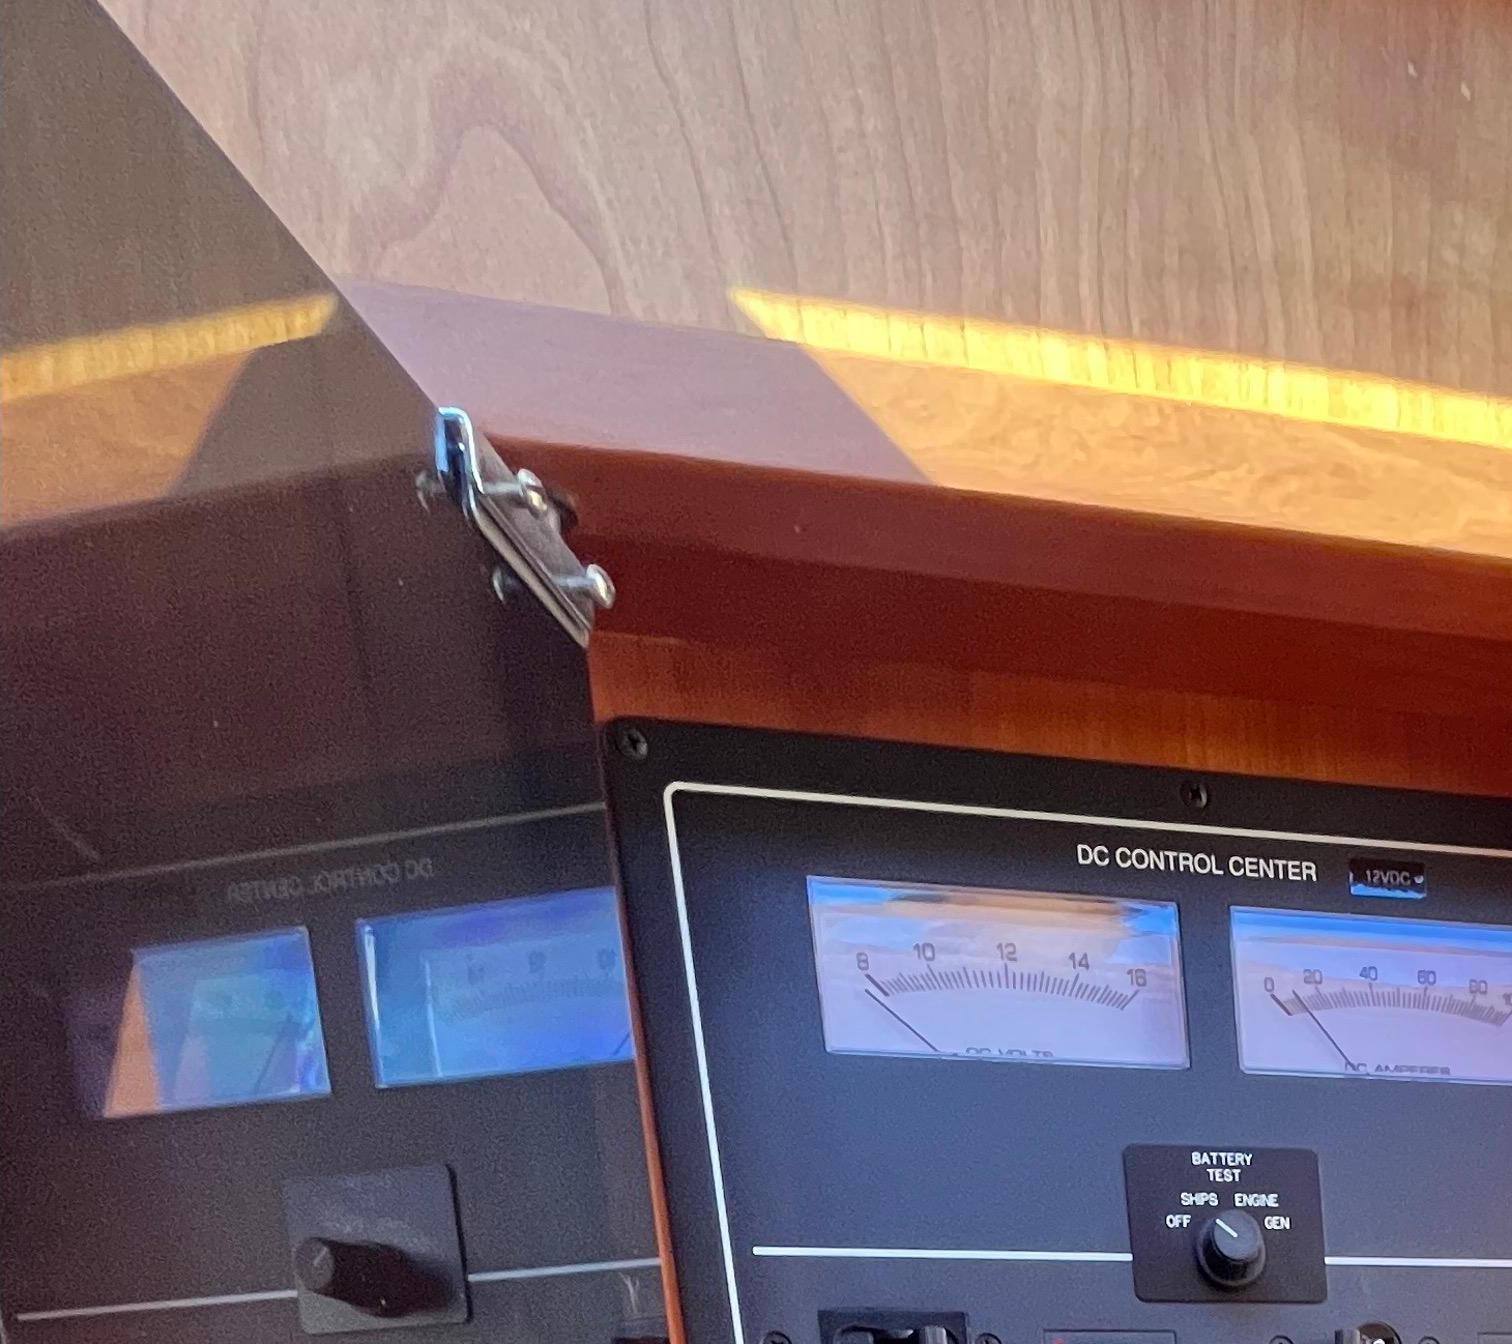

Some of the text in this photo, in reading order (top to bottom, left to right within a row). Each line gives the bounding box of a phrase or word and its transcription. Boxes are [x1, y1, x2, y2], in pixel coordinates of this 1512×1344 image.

[1076, 844, 1318, 881] DC CONTROL CENTER
[1365, 869, 1412, 887] 12VDC
[913, 942, 936, 962] 10
[996, 942, 1017, 962] 12
[856, 952, 869, 971] 8
[1068, 952, 1090, 971] 14
[1127, 968, 1148, 988] 16
[1303, 969, 1323, 985] 20
[1359, 966, 1378, 982] 40
[1417, 969, 1437, 986] 60
[1264, 976, 1274, 993] 0
[1469, 979, 1488, 995] 80
[1191, 1151, 1253, 1166] BATTERY
[1206, 1168, 1241, 1182] TEST
[1180, 1192, 1279, 1207] SHIPS ENGINE
[1165, 1214, 1191, 1228] OFF
[1264, 1216, 1290, 1230] GEN
